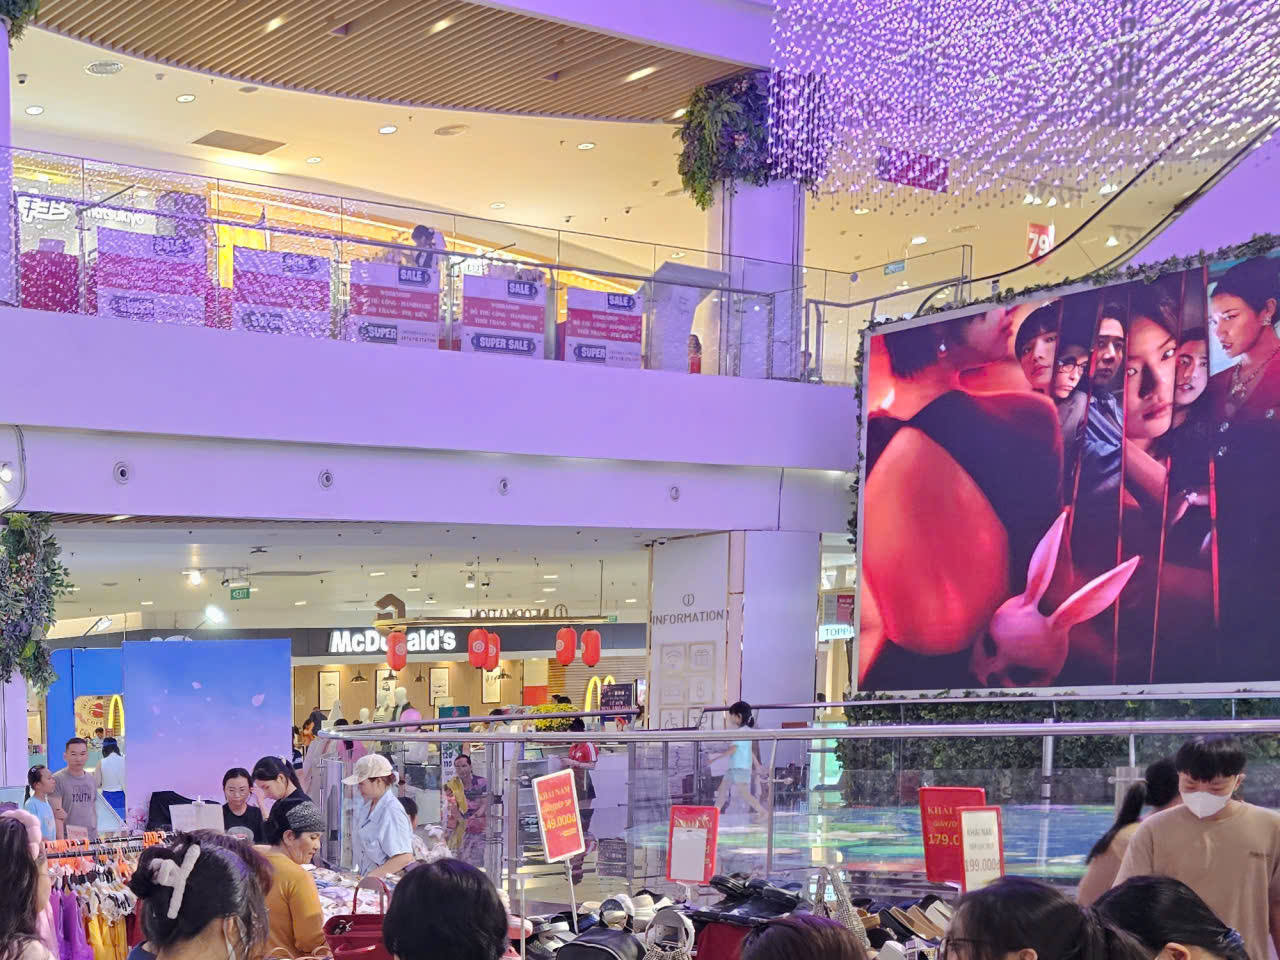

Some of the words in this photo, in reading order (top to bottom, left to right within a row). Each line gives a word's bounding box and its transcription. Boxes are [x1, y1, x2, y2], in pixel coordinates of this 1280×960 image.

[1028, 233, 1050, 256] 79
[400, 269, 423, 282] SALE
[509, 283, 530, 295] SALE
[367, 326, 397, 339] SUPER
[480, 337, 507, 349] SUPER
[508, 339, 529, 351] SALE
[581, 346, 606, 359] SUPER
[652, 609, 724, 625] INFORMATION
[330, 630, 456, 653] McDald's
[72, 793, 91, 802] YOUTH
